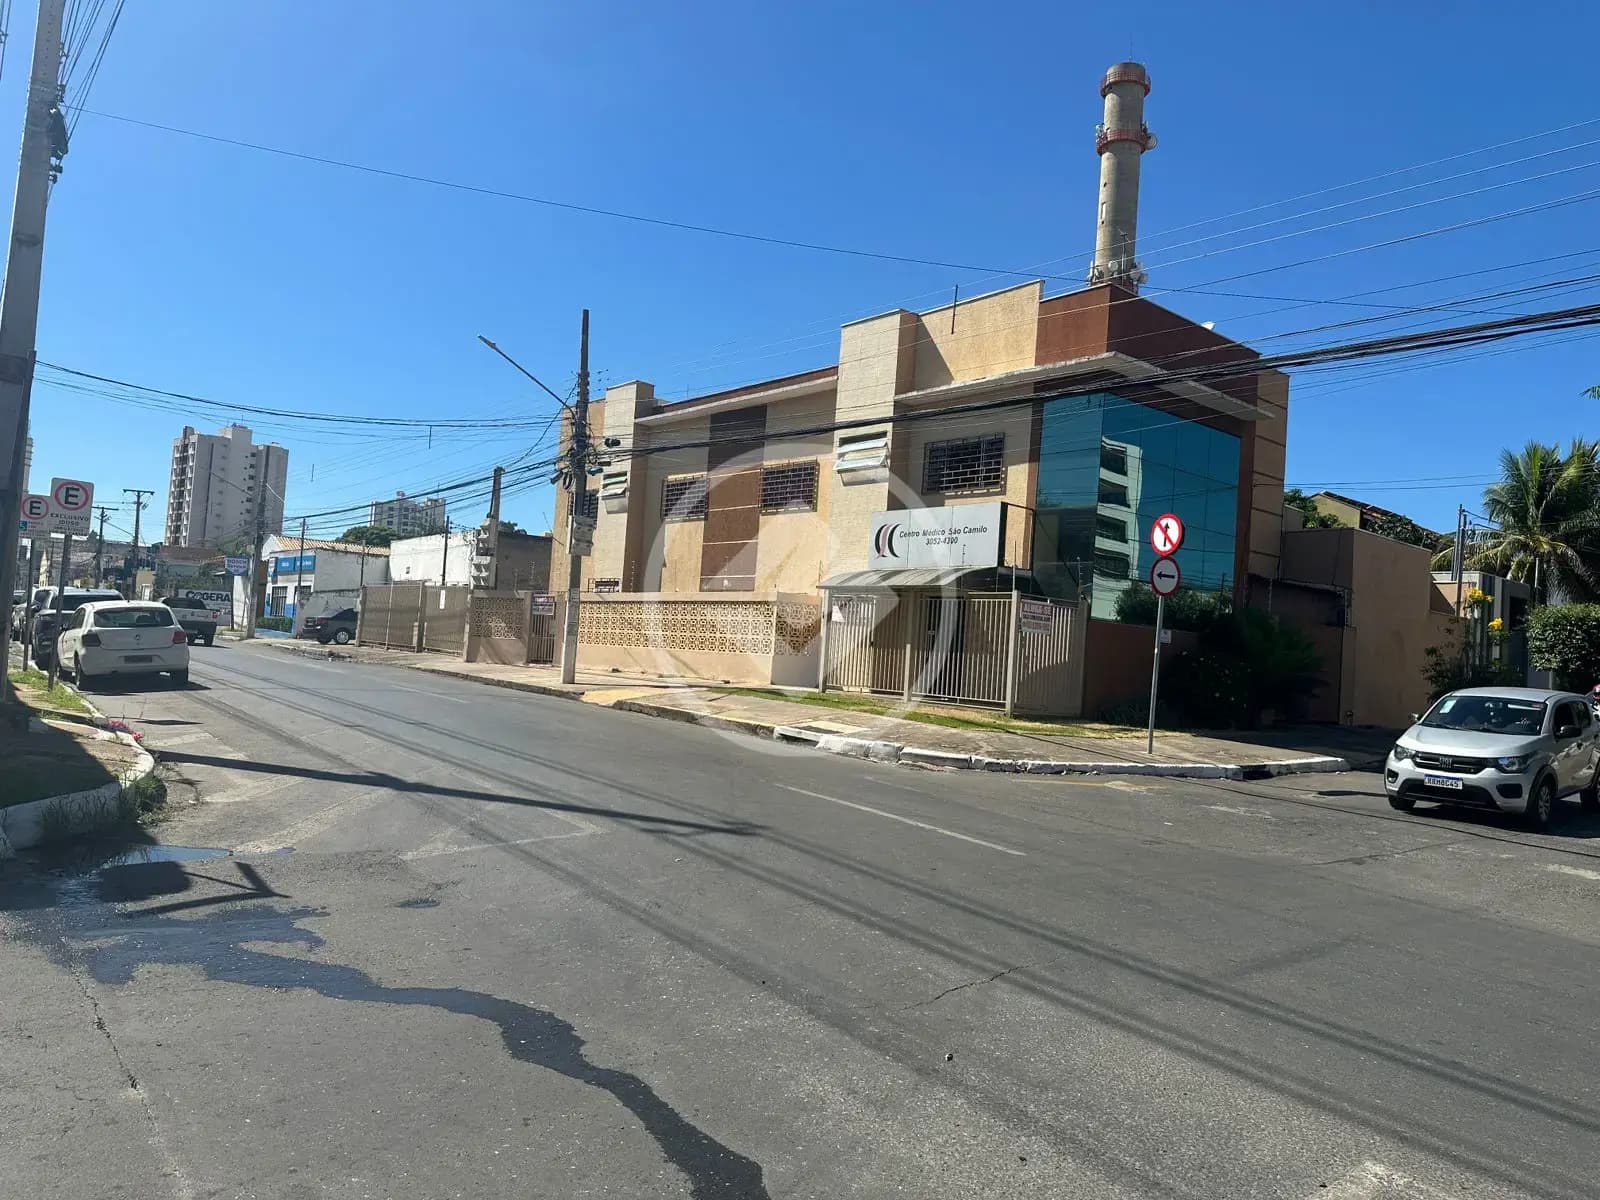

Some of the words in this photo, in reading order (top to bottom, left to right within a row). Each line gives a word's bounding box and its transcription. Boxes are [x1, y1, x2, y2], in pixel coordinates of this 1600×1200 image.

[64, 486, 80, 506] E
[29, 500, 42, 516] E
[899, 529, 920, 539] Centro
[963, 524, 988, 535] Camilo
